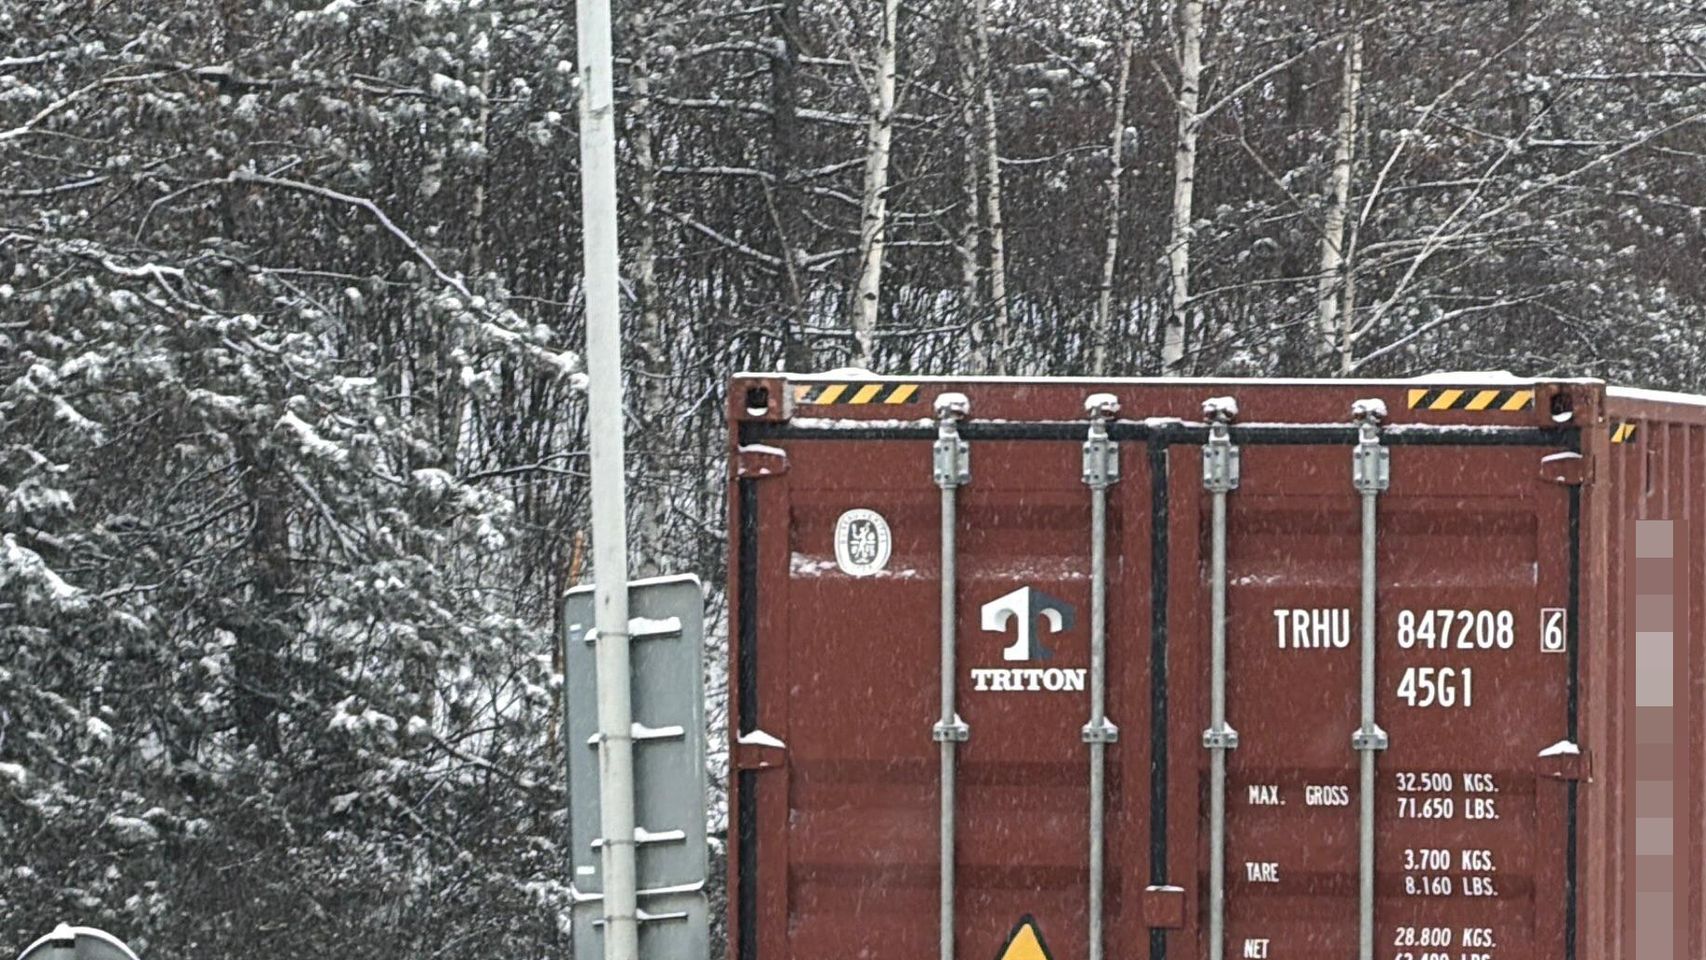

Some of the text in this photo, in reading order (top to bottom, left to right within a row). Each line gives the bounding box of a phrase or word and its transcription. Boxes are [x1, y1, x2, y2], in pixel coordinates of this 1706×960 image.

[1273, 608, 1563, 650] TRHU 847208 6
[971, 668, 1087, 692] TRITON
[1396, 667, 1472, 708] 45G1
[1396, 772, 1500, 793] 32.500 KGS.
[1249, 785, 1350, 806] MAX. GROSS
[1397, 797, 1500, 820] 71.650 LBS.
[1404, 849, 1497, 871] 3.700 KGS.
[1245, 862, 1280, 882] TARE
[1405, 876, 1499, 896] 8.160 LBS.
[1394, 927, 1497, 948] 28.800 KGS.
[1243, 938, 1270, 959] NET
